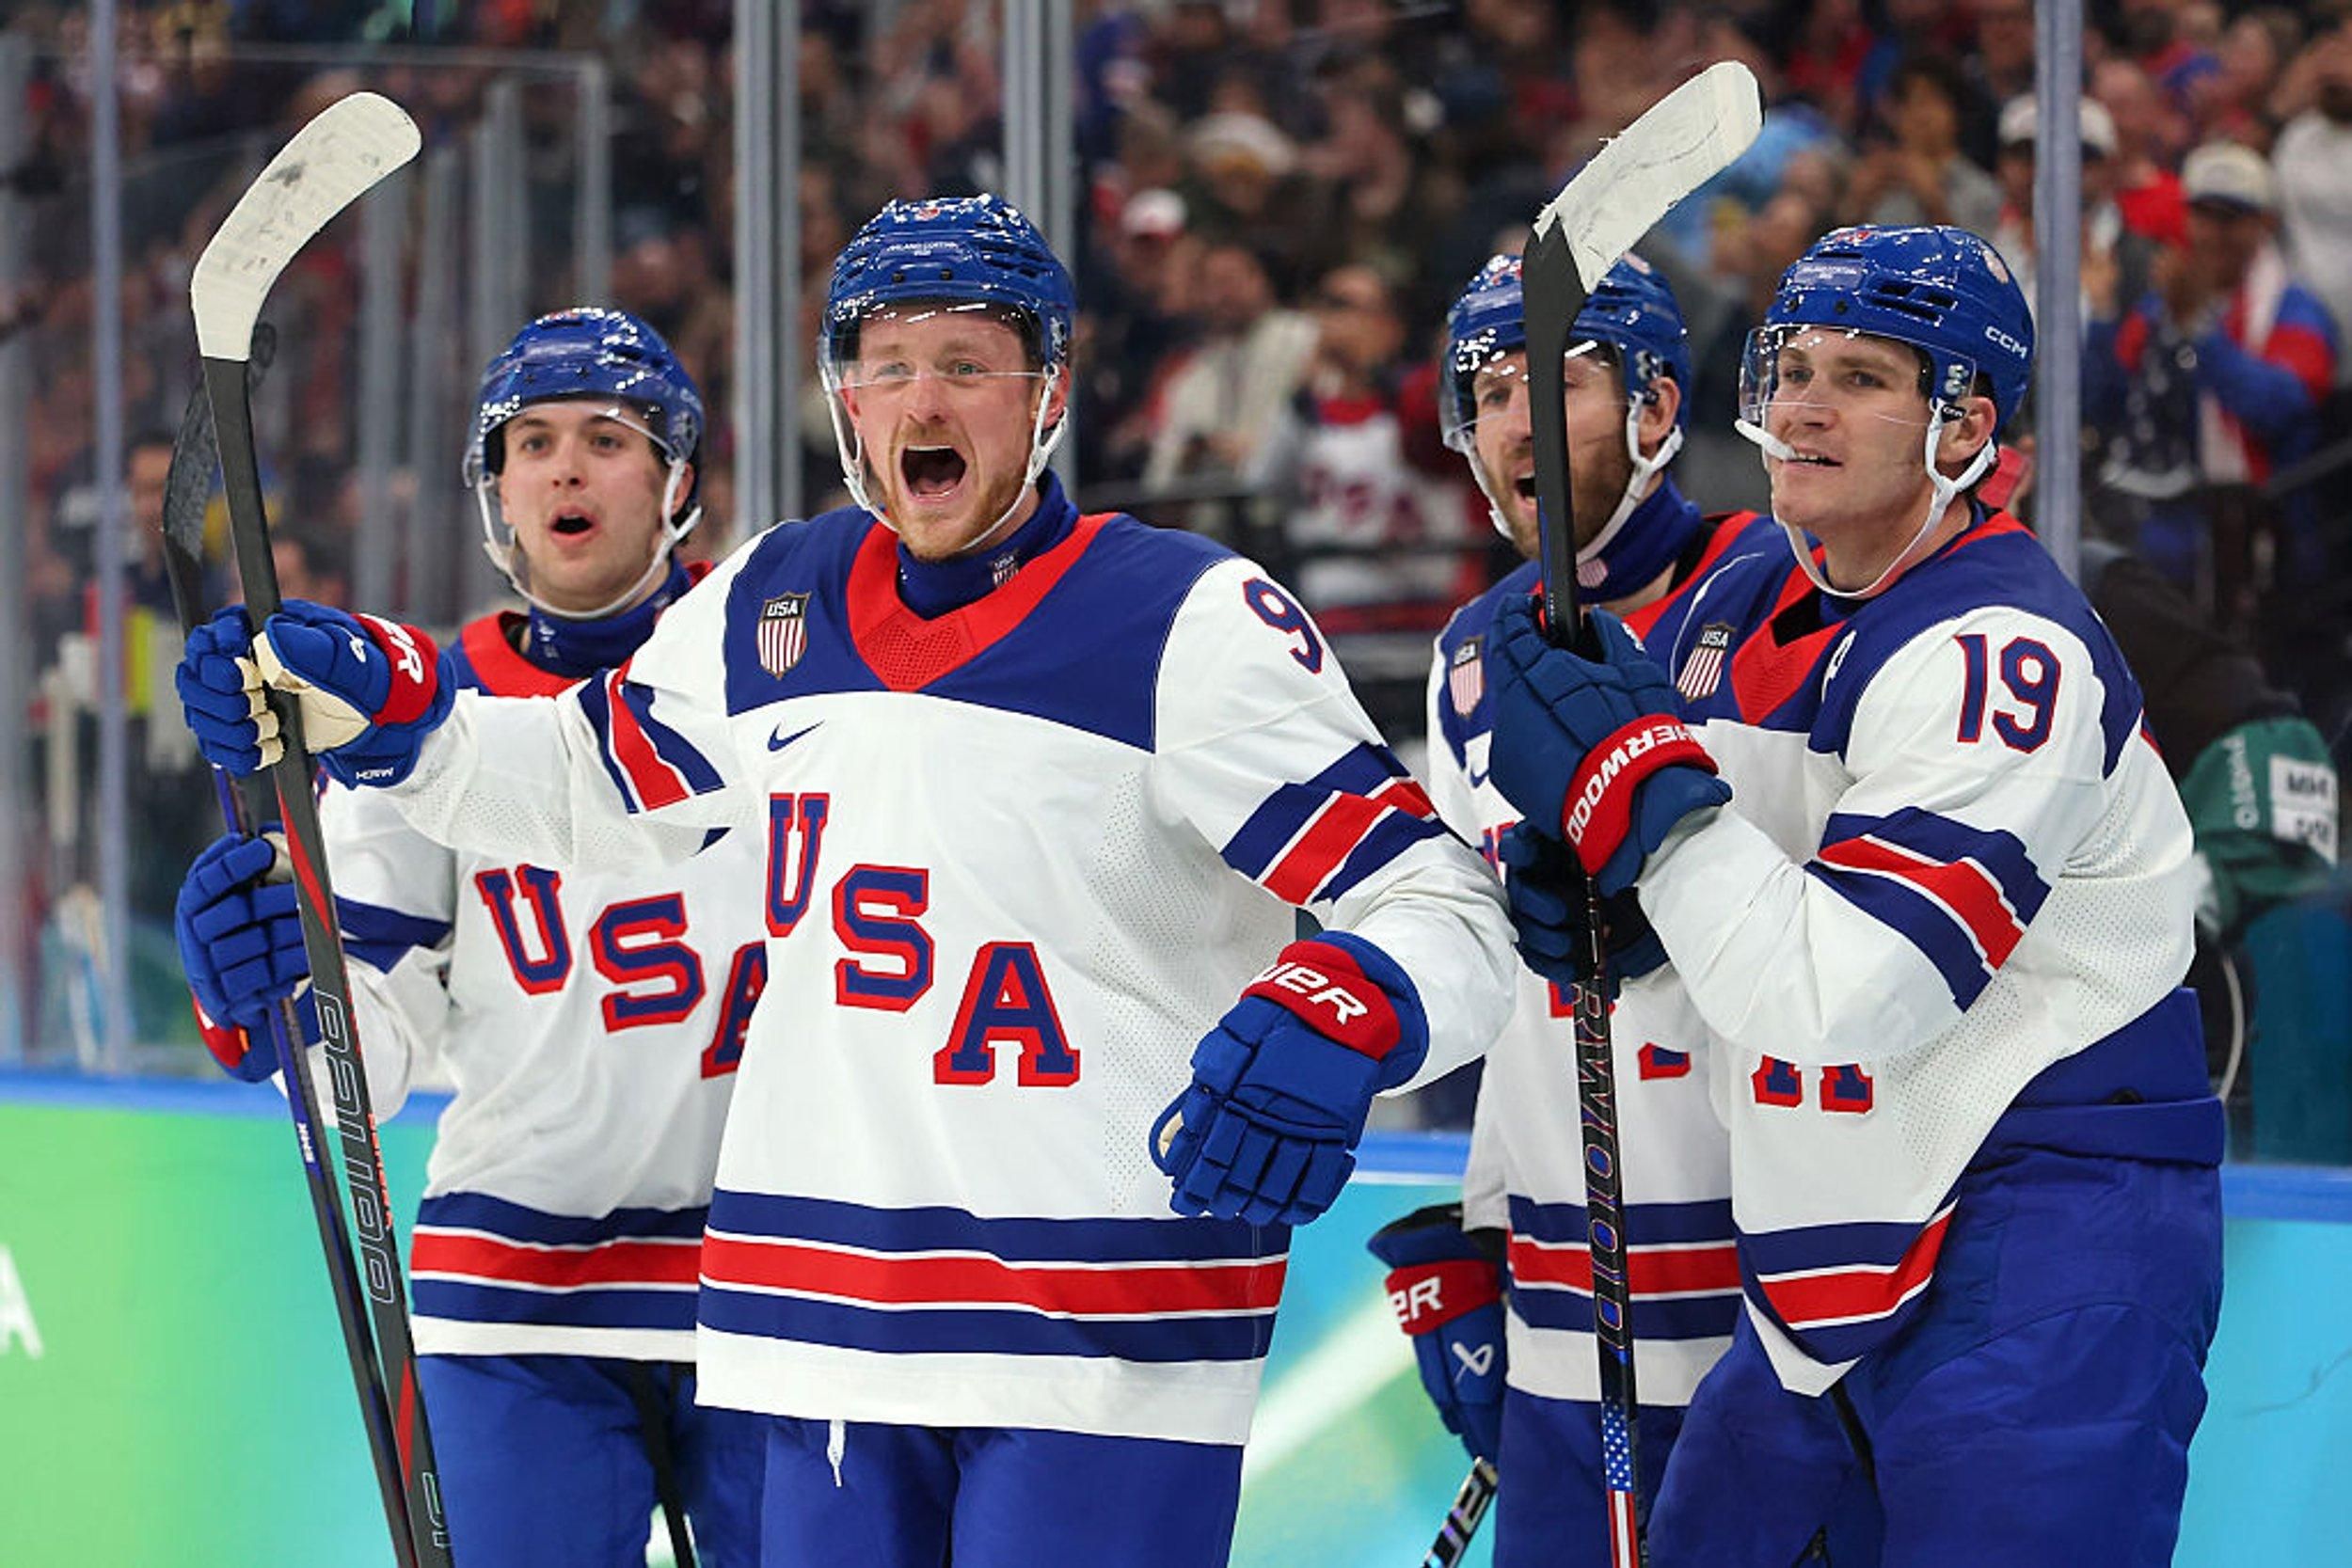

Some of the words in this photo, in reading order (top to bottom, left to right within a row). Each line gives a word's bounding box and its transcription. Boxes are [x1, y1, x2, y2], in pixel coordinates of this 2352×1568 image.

[1984, 326, 2027, 359] CCM
[767, 598, 799, 617] USA
[1242, 577, 1324, 674] 9
[1702, 630, 1729, 647] USA
[1953, 633, 2061, 754] 19
[765, 792, 1081, 1087] USA
